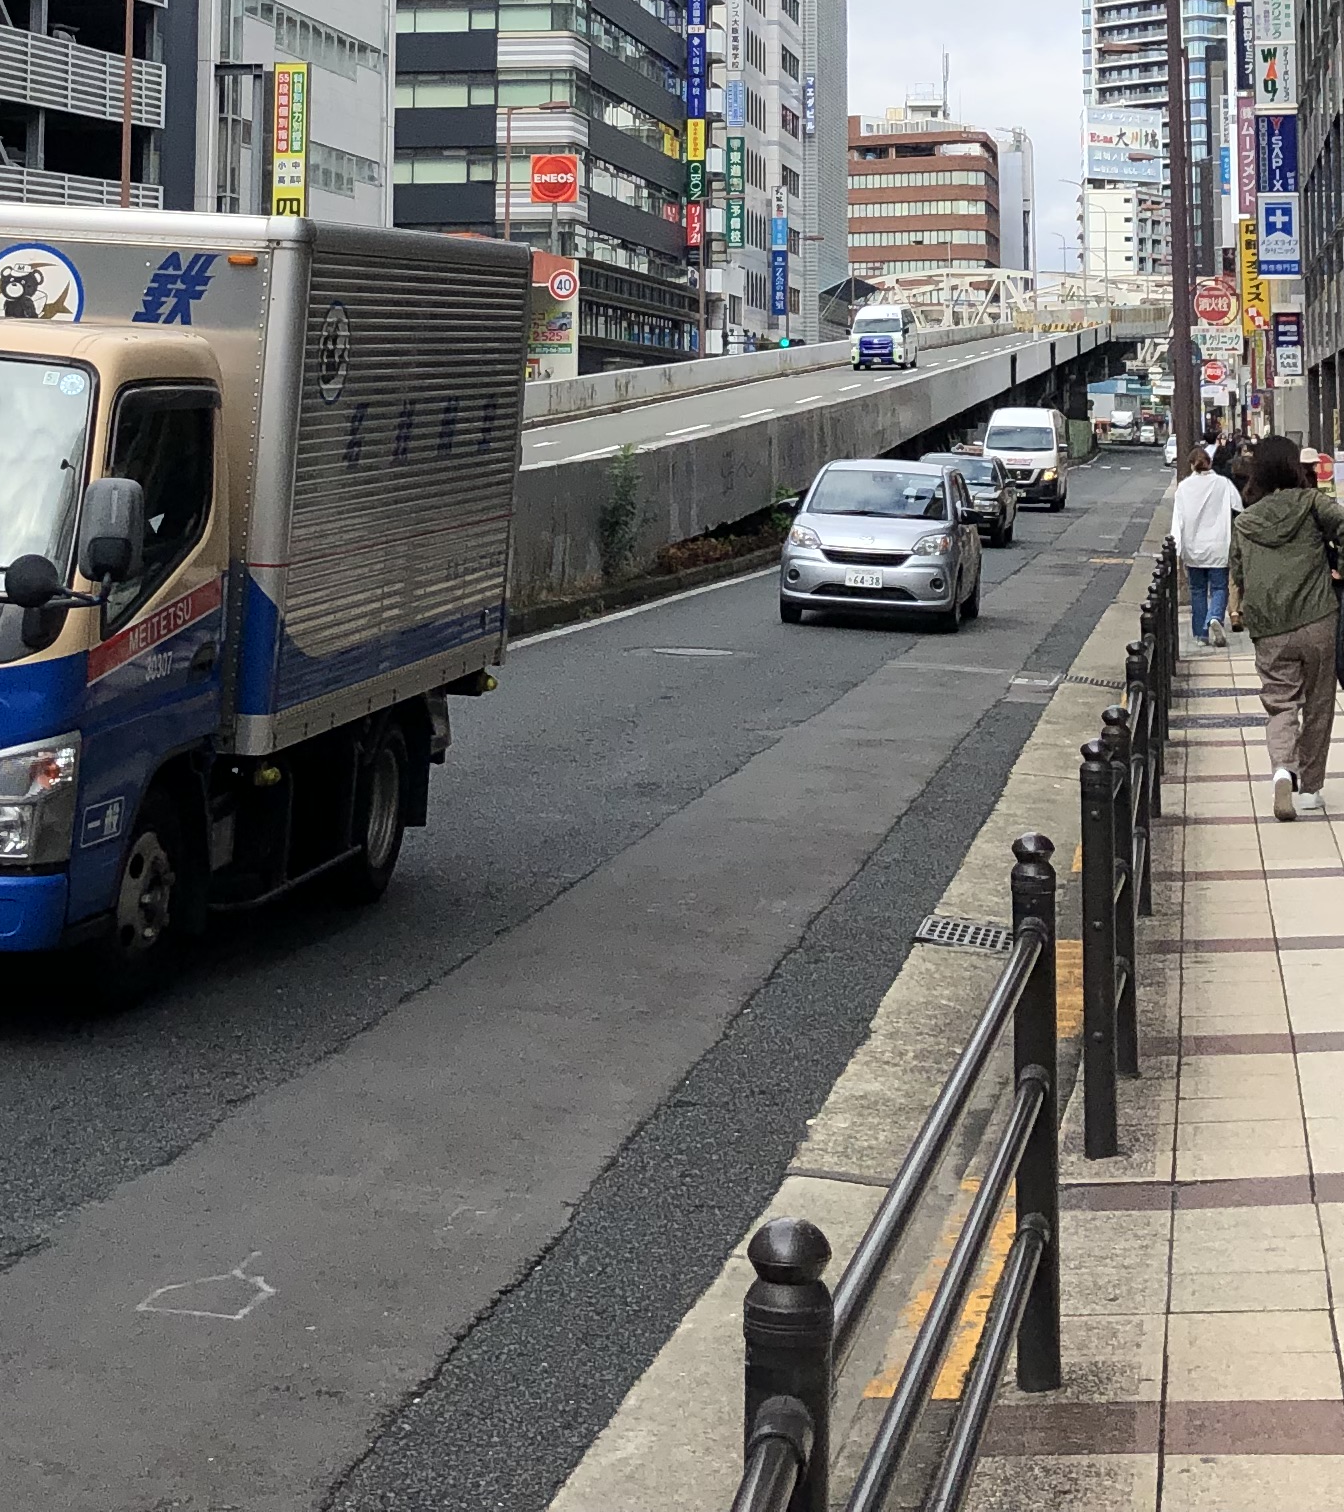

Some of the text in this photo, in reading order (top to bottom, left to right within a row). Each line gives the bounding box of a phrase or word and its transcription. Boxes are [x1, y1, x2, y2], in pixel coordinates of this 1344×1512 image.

[806, 76, 815, 131] マエダビル
[277, 160, 301, 170] 小 中
[277, 174, 287, 185] 高
[532, 172, 576, 185] ENEOS
[690, 205, 701, 244] リーブ21
[1264, 247, 1296, 255] クリニック
[131, 250, 223, 327] 鉄
[556, 278, 573, 292] 40
[774, 267, 785, 311] Z会の教室
[1198, 296, 1229, 312] 消火栓
[128, 596, 193, 653] MEITETSU
